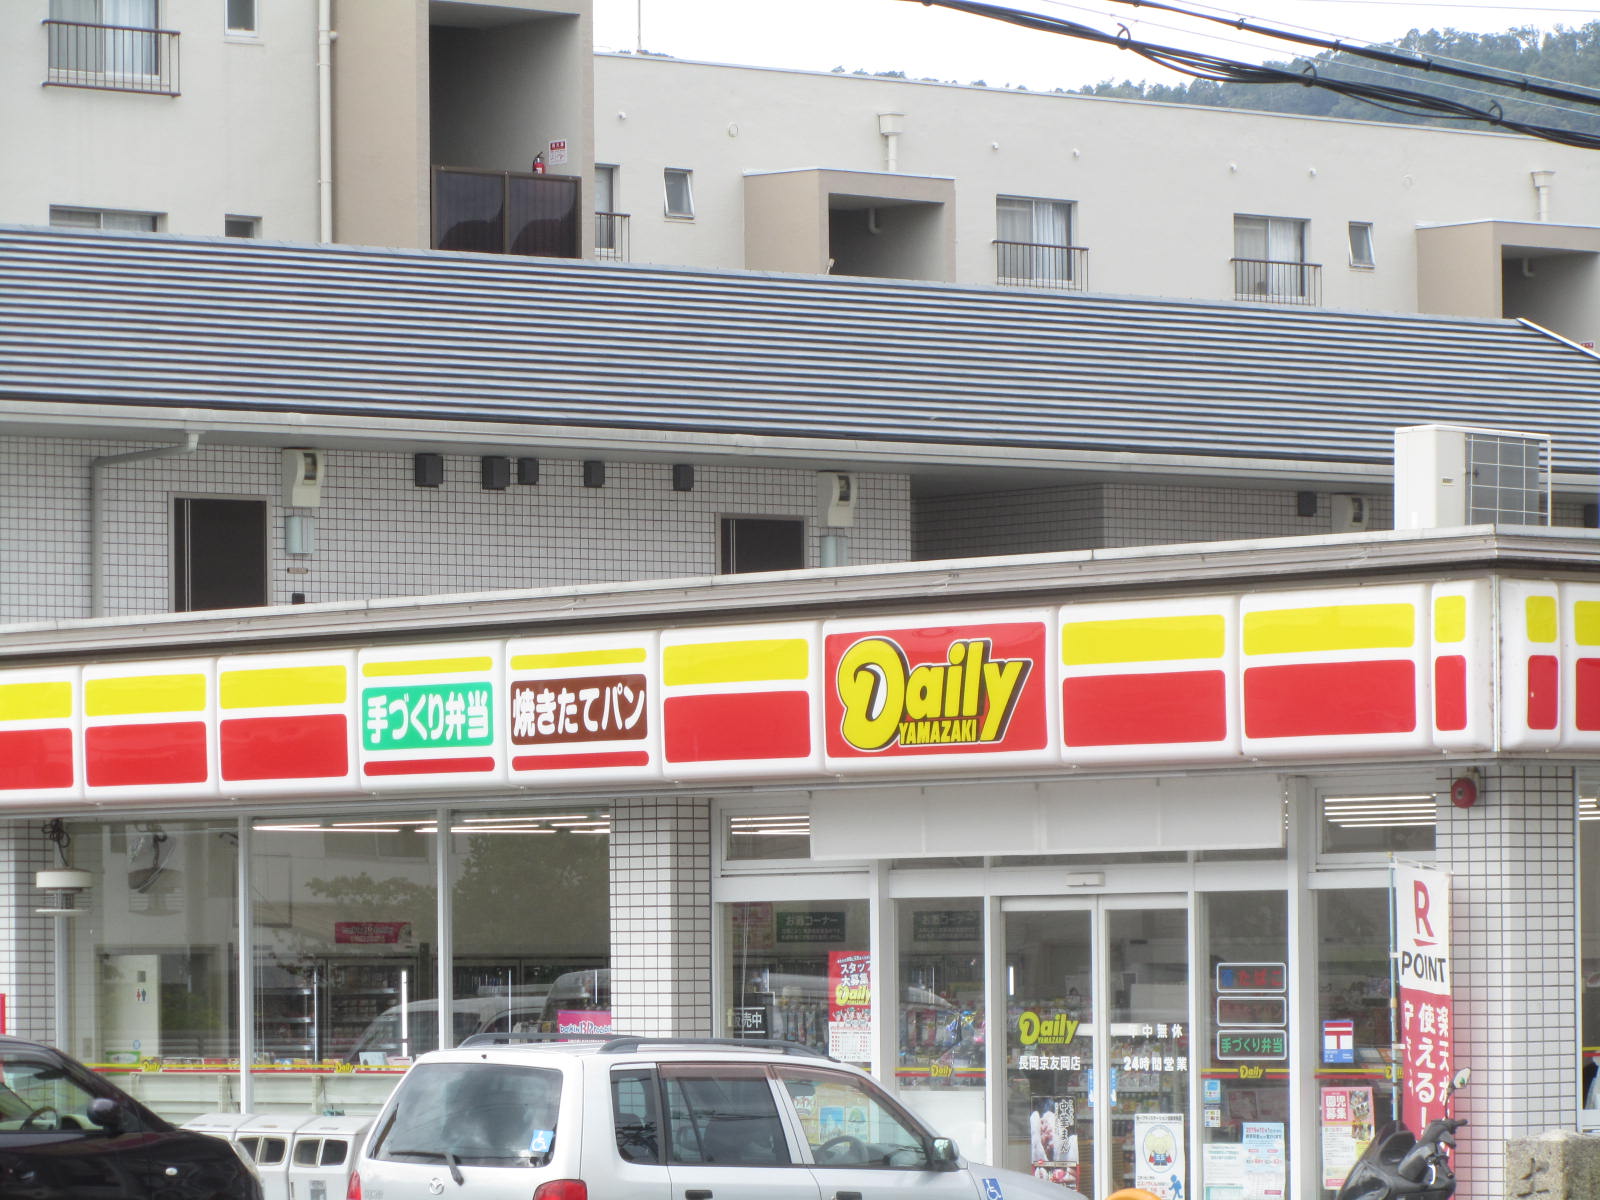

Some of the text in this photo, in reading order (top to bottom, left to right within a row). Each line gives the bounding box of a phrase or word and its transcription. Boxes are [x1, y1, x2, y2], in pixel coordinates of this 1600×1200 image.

[513, 682, 645, 737] 焼きたてパン
[837, 637, 1032, 750] Daily
[367, 690, 489, 744] 手づくり弁当
[898, 718, 977, 745] YAMAZAKI
[1413, 879, 1435, 938] R
[1401, 950, 1447, 983] POINT
[1019, 1010, 1079, 1045] Daily
[1221, 1038, 1283, 1053] 手づくり弁当
[1018, 1055, 1081, 1070] 長岡京友岡店
[1123, 1056, 1188, 1072] 24時間営業
[1239, 1065, 1264, 1079] Daily
